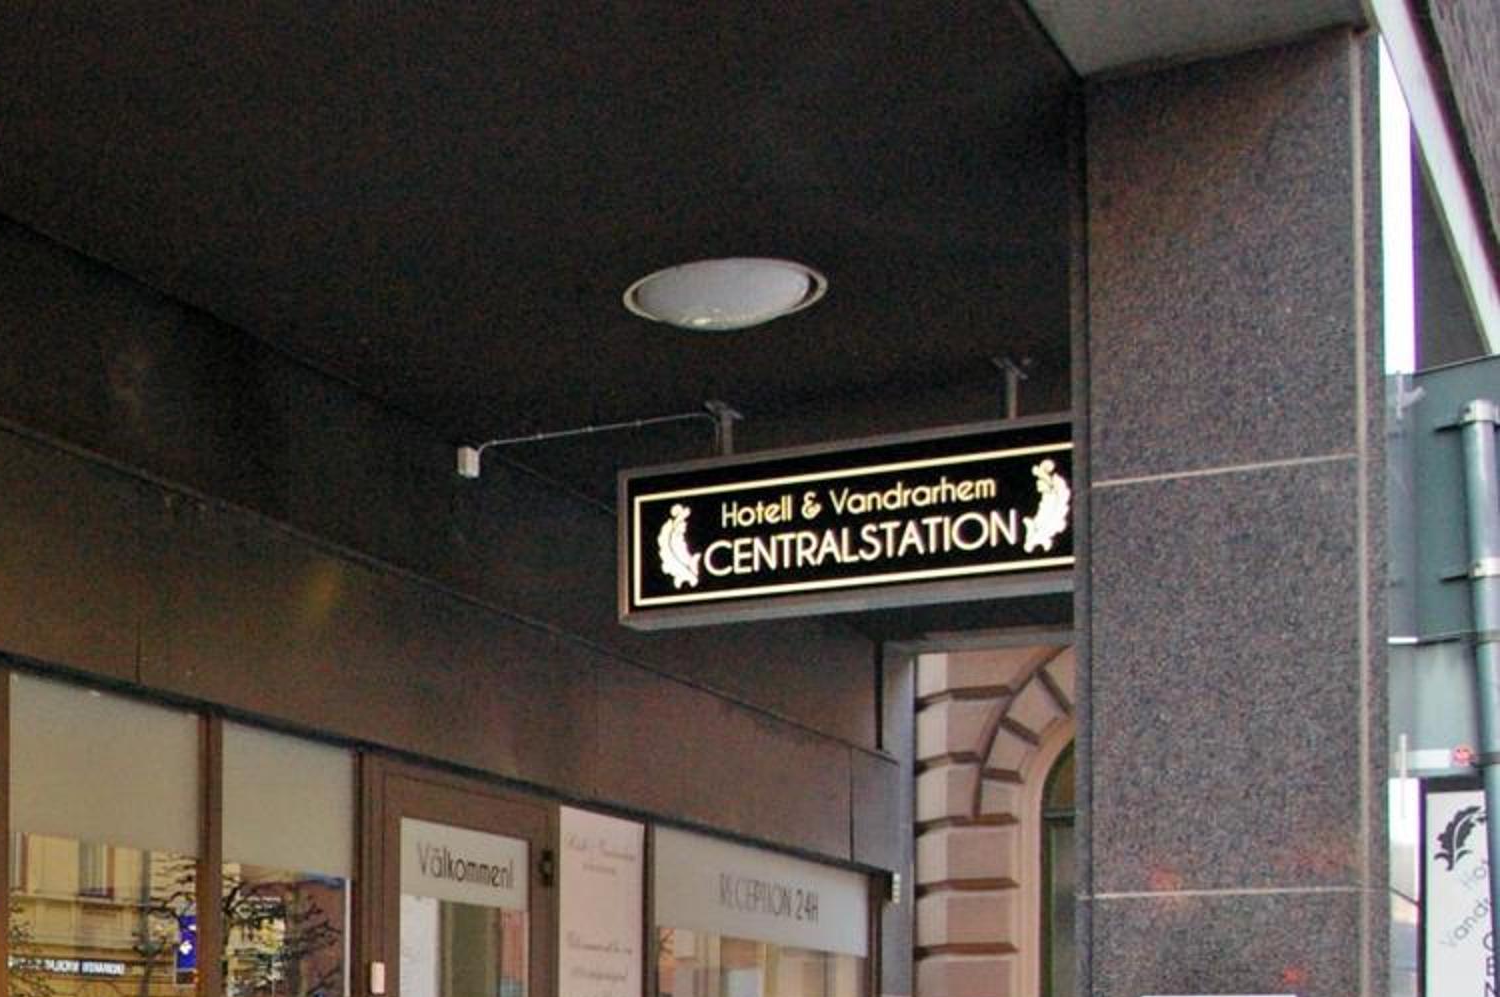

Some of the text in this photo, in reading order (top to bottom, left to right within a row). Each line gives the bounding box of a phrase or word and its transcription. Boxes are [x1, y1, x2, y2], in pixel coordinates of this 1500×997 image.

[721, 477, 996, 528] Hotell & Vandrarhem
[704, 509, 1018, 578] CENTRALSTATION
[417, 841, 514, 888] Välkommen!
